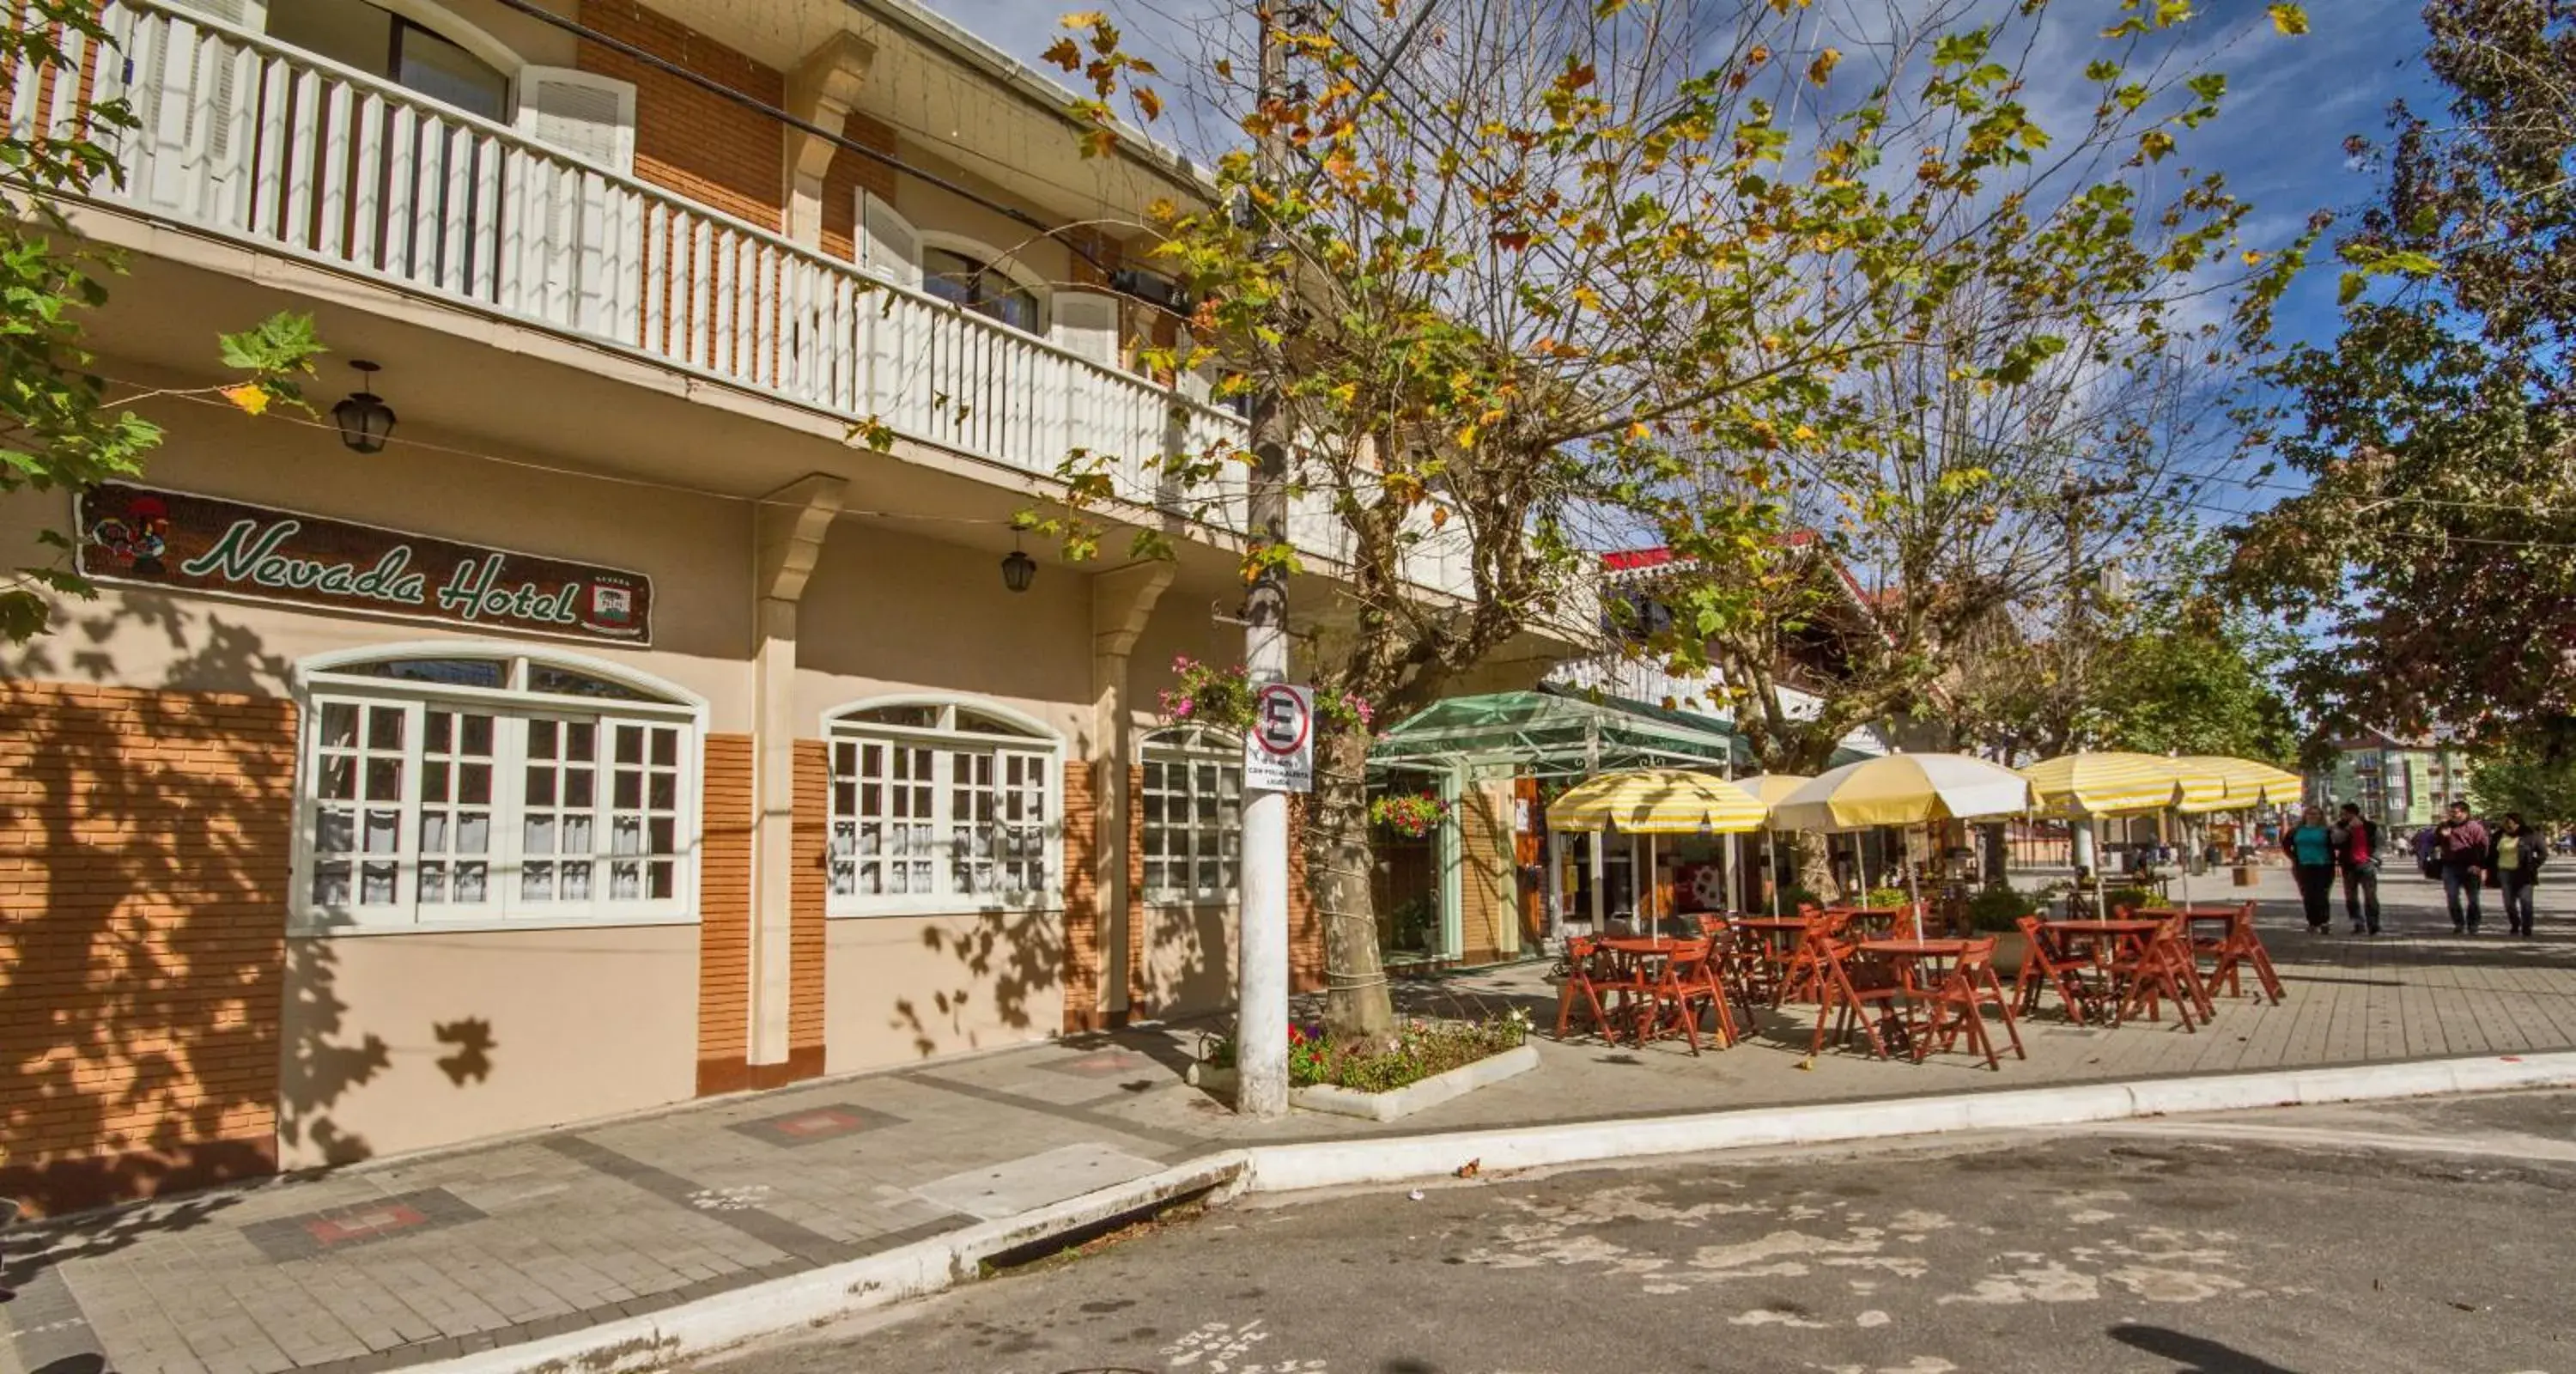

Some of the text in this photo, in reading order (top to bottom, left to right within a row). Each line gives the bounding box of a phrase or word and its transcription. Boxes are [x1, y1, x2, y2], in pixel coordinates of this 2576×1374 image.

[181, 520, 580, 623] Nevada Hotel
[1267, 697, 1294, 742] E
